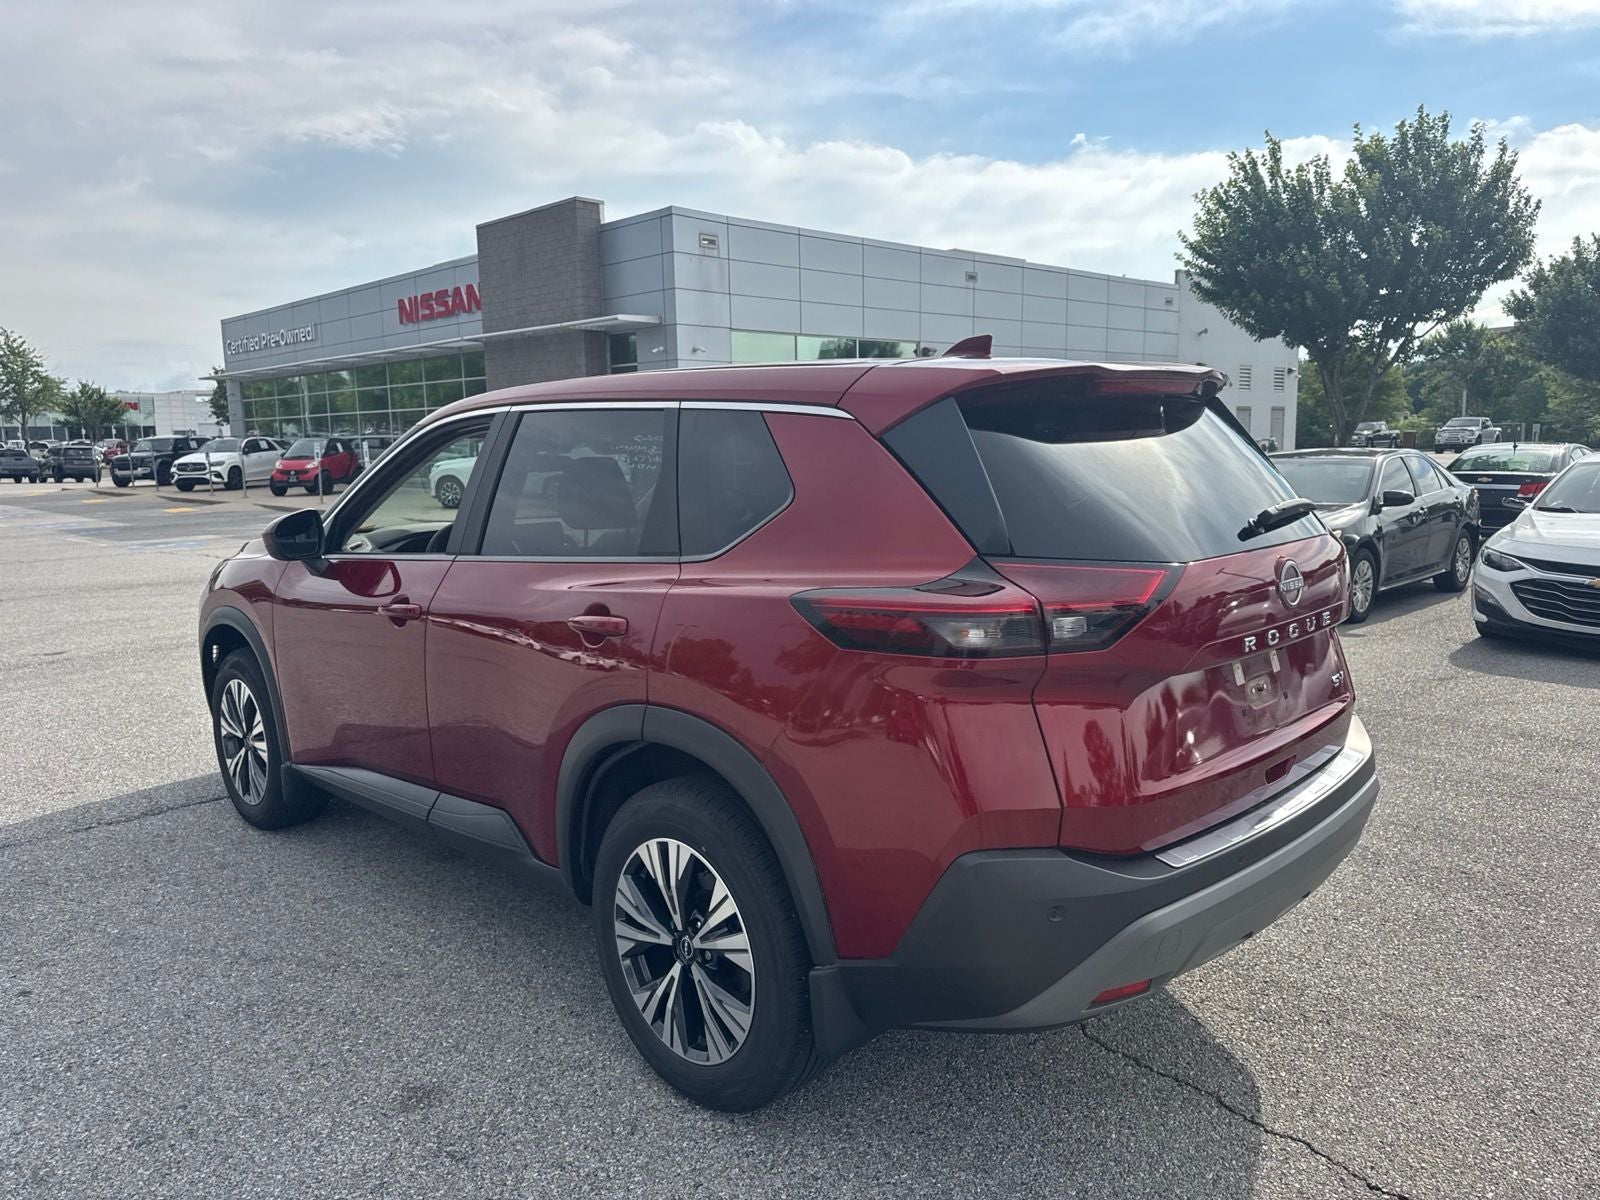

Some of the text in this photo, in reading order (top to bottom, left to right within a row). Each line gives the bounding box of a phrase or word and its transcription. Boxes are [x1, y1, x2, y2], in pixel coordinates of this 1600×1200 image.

[398, 284, 482, 325] NISSAN
[225, 322, 315, 355] Certified Pre-Owned
[1280, 578, 1303, 591] NISS
[1244, 611, 1331, 653] ROGUE
